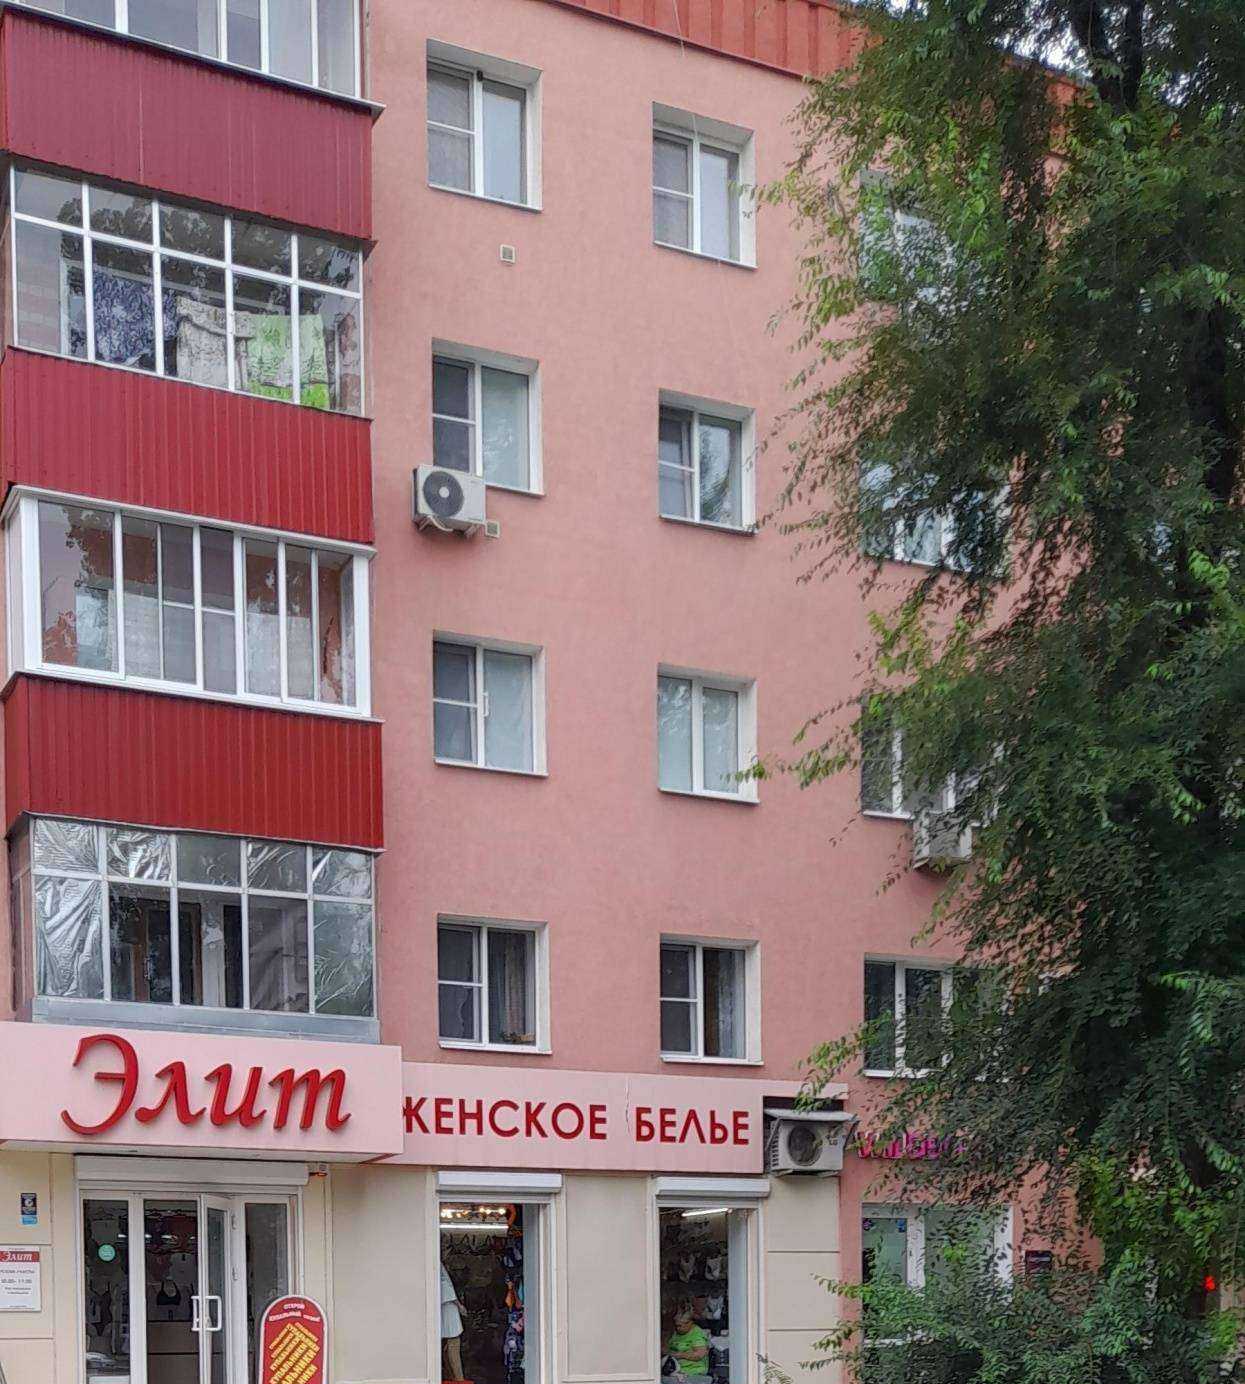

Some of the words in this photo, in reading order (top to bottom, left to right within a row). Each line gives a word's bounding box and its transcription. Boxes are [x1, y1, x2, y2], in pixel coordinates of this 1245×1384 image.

[60, 1033, 352, 1135] Элит
[402, 1096, 607, 1140] ЖЕНСКОЕ
[635, 1106, 750, 1145] БЕЛЬЕ
